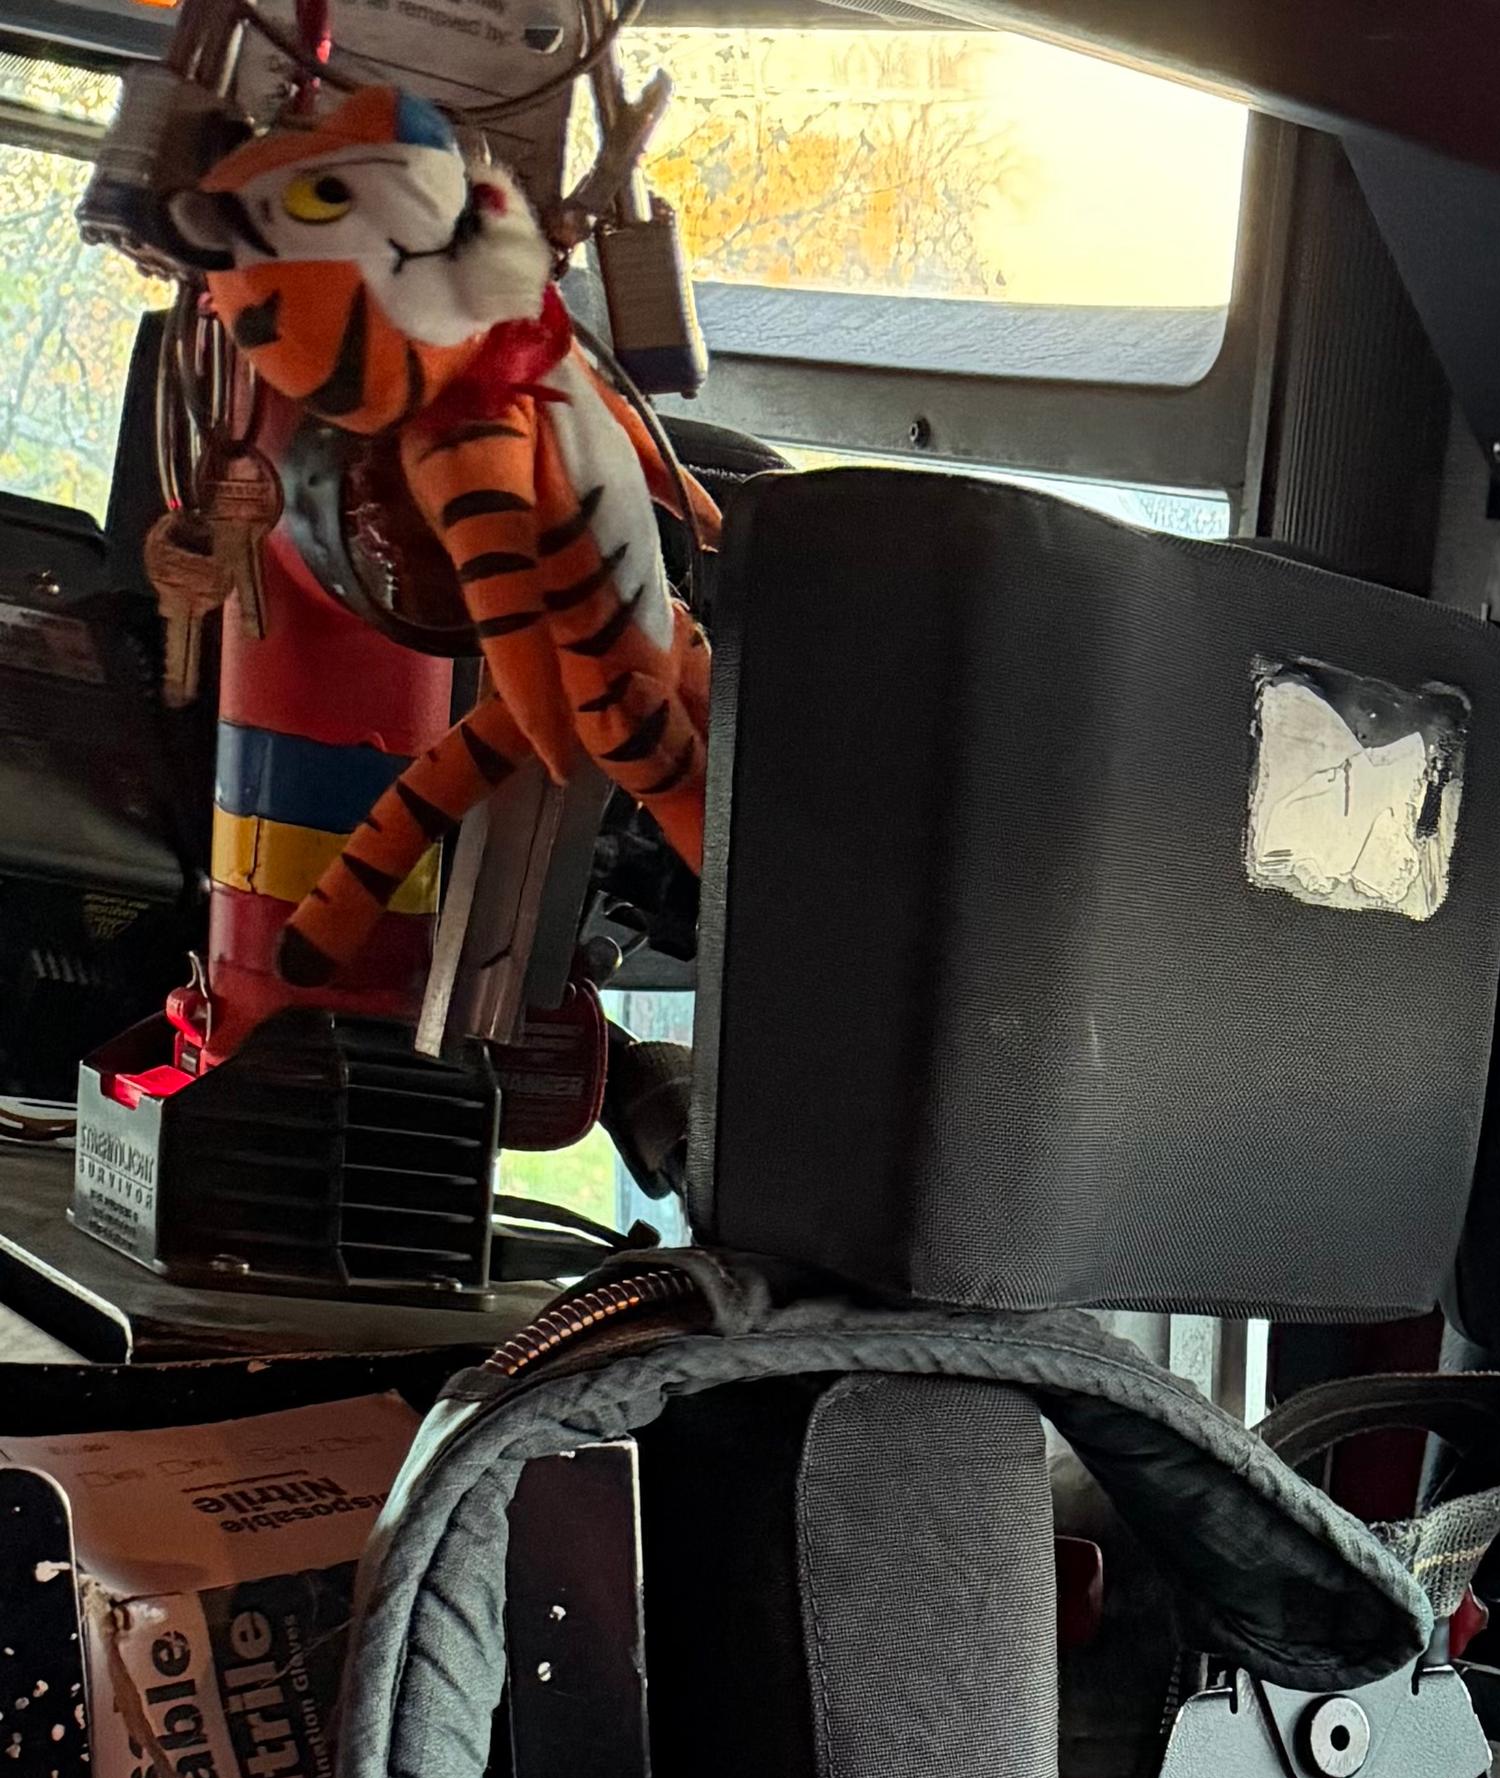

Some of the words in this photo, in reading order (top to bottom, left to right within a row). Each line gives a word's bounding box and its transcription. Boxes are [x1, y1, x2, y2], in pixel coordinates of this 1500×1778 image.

[78, 1157, 153, 1210] SURVIVOR
[193, 1477, 346, 1514] Nitrile
[220, 1492, 389, 1534] isposable
